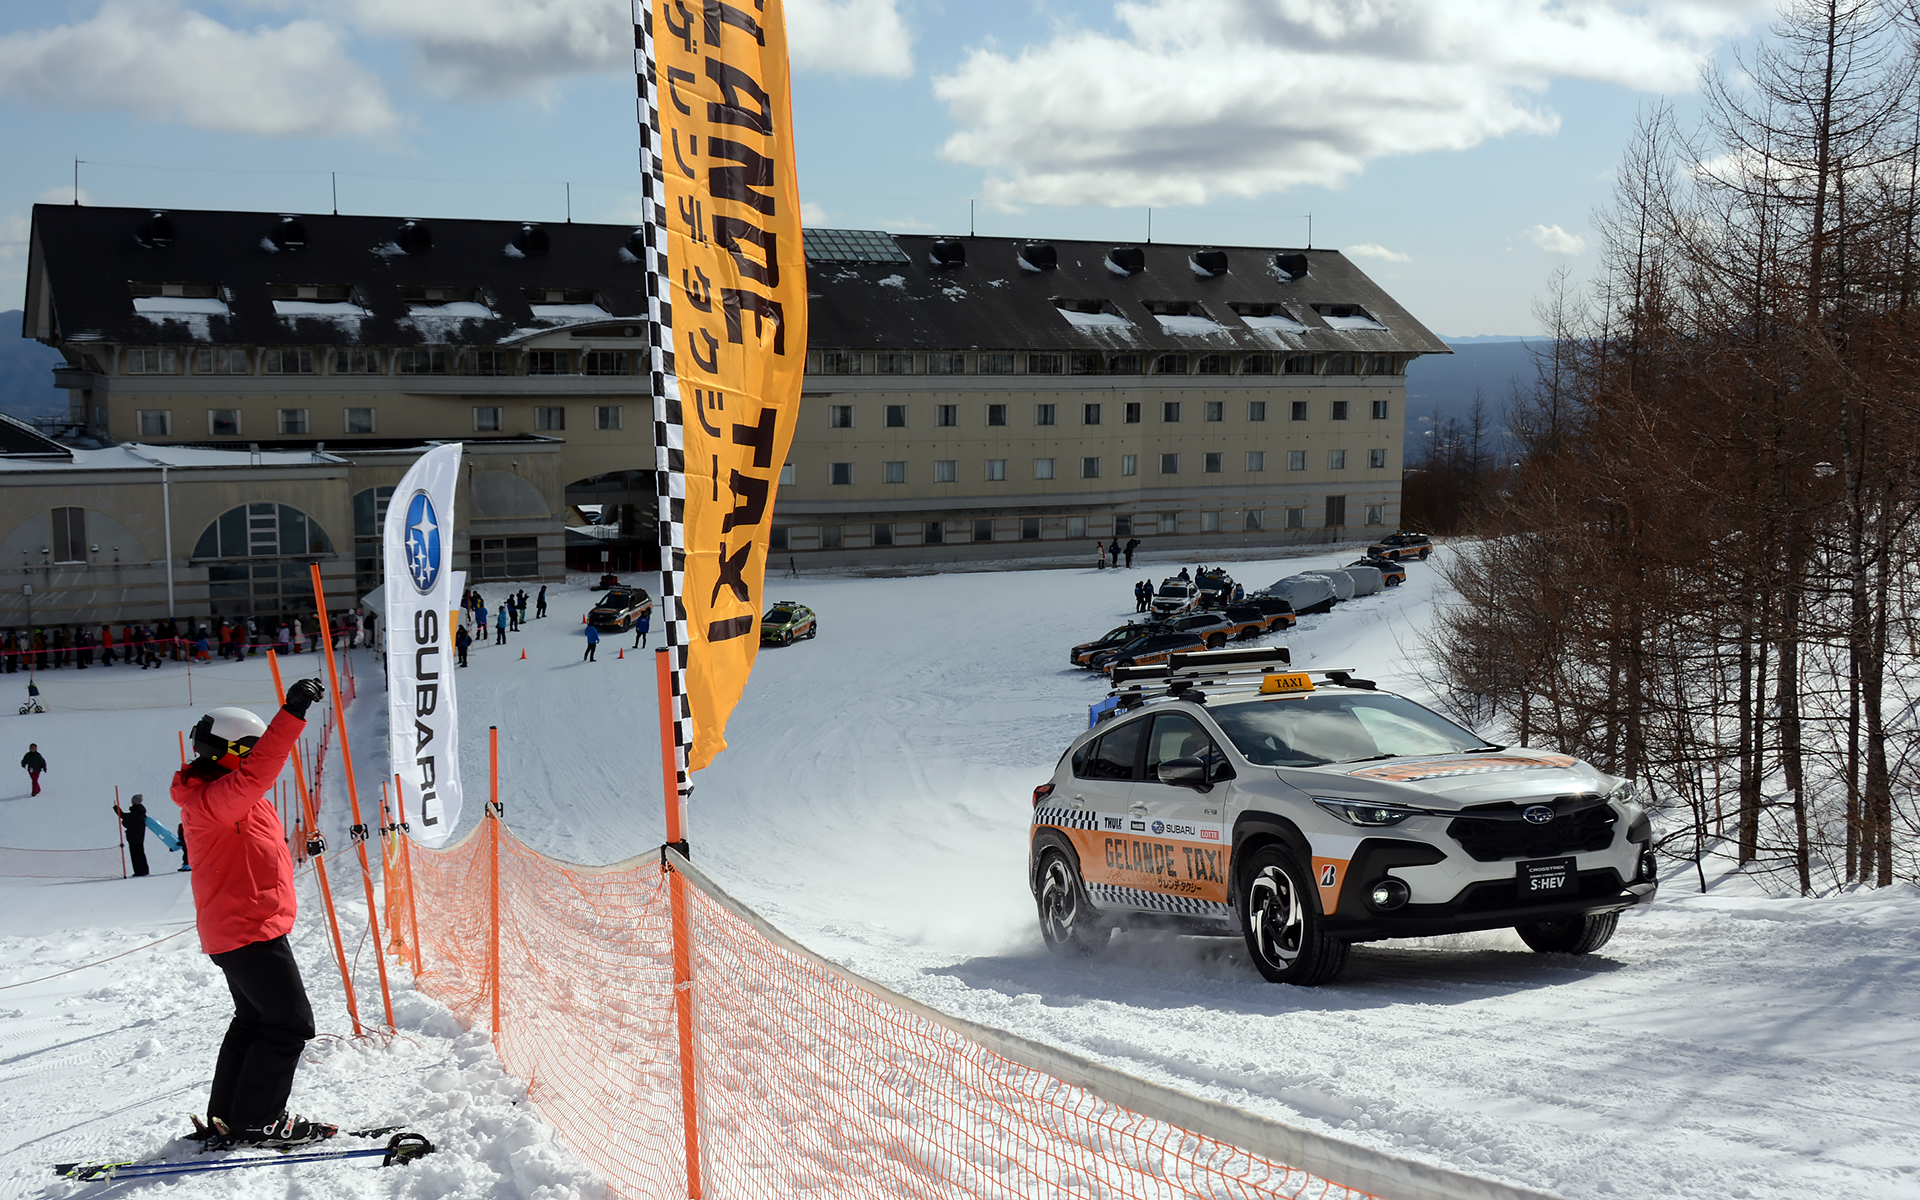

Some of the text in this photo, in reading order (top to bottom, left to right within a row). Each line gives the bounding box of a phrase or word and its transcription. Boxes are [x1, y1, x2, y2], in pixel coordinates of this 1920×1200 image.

[703, 0, 785, 643] LANDE TAXI
[1275, 678, 1303, 688] TAXI
[413, 608, 439, 827] SUBARU
[1104, 817, 1124, 830] THULE
[1166, 823, 1196, 835] SUBARU
[1201, 830, 1218, 839] LOTTE
[1105, 837, 1224, 884] GELANDE TAXI
[1531, 876, 1565, 891] S:HEV
